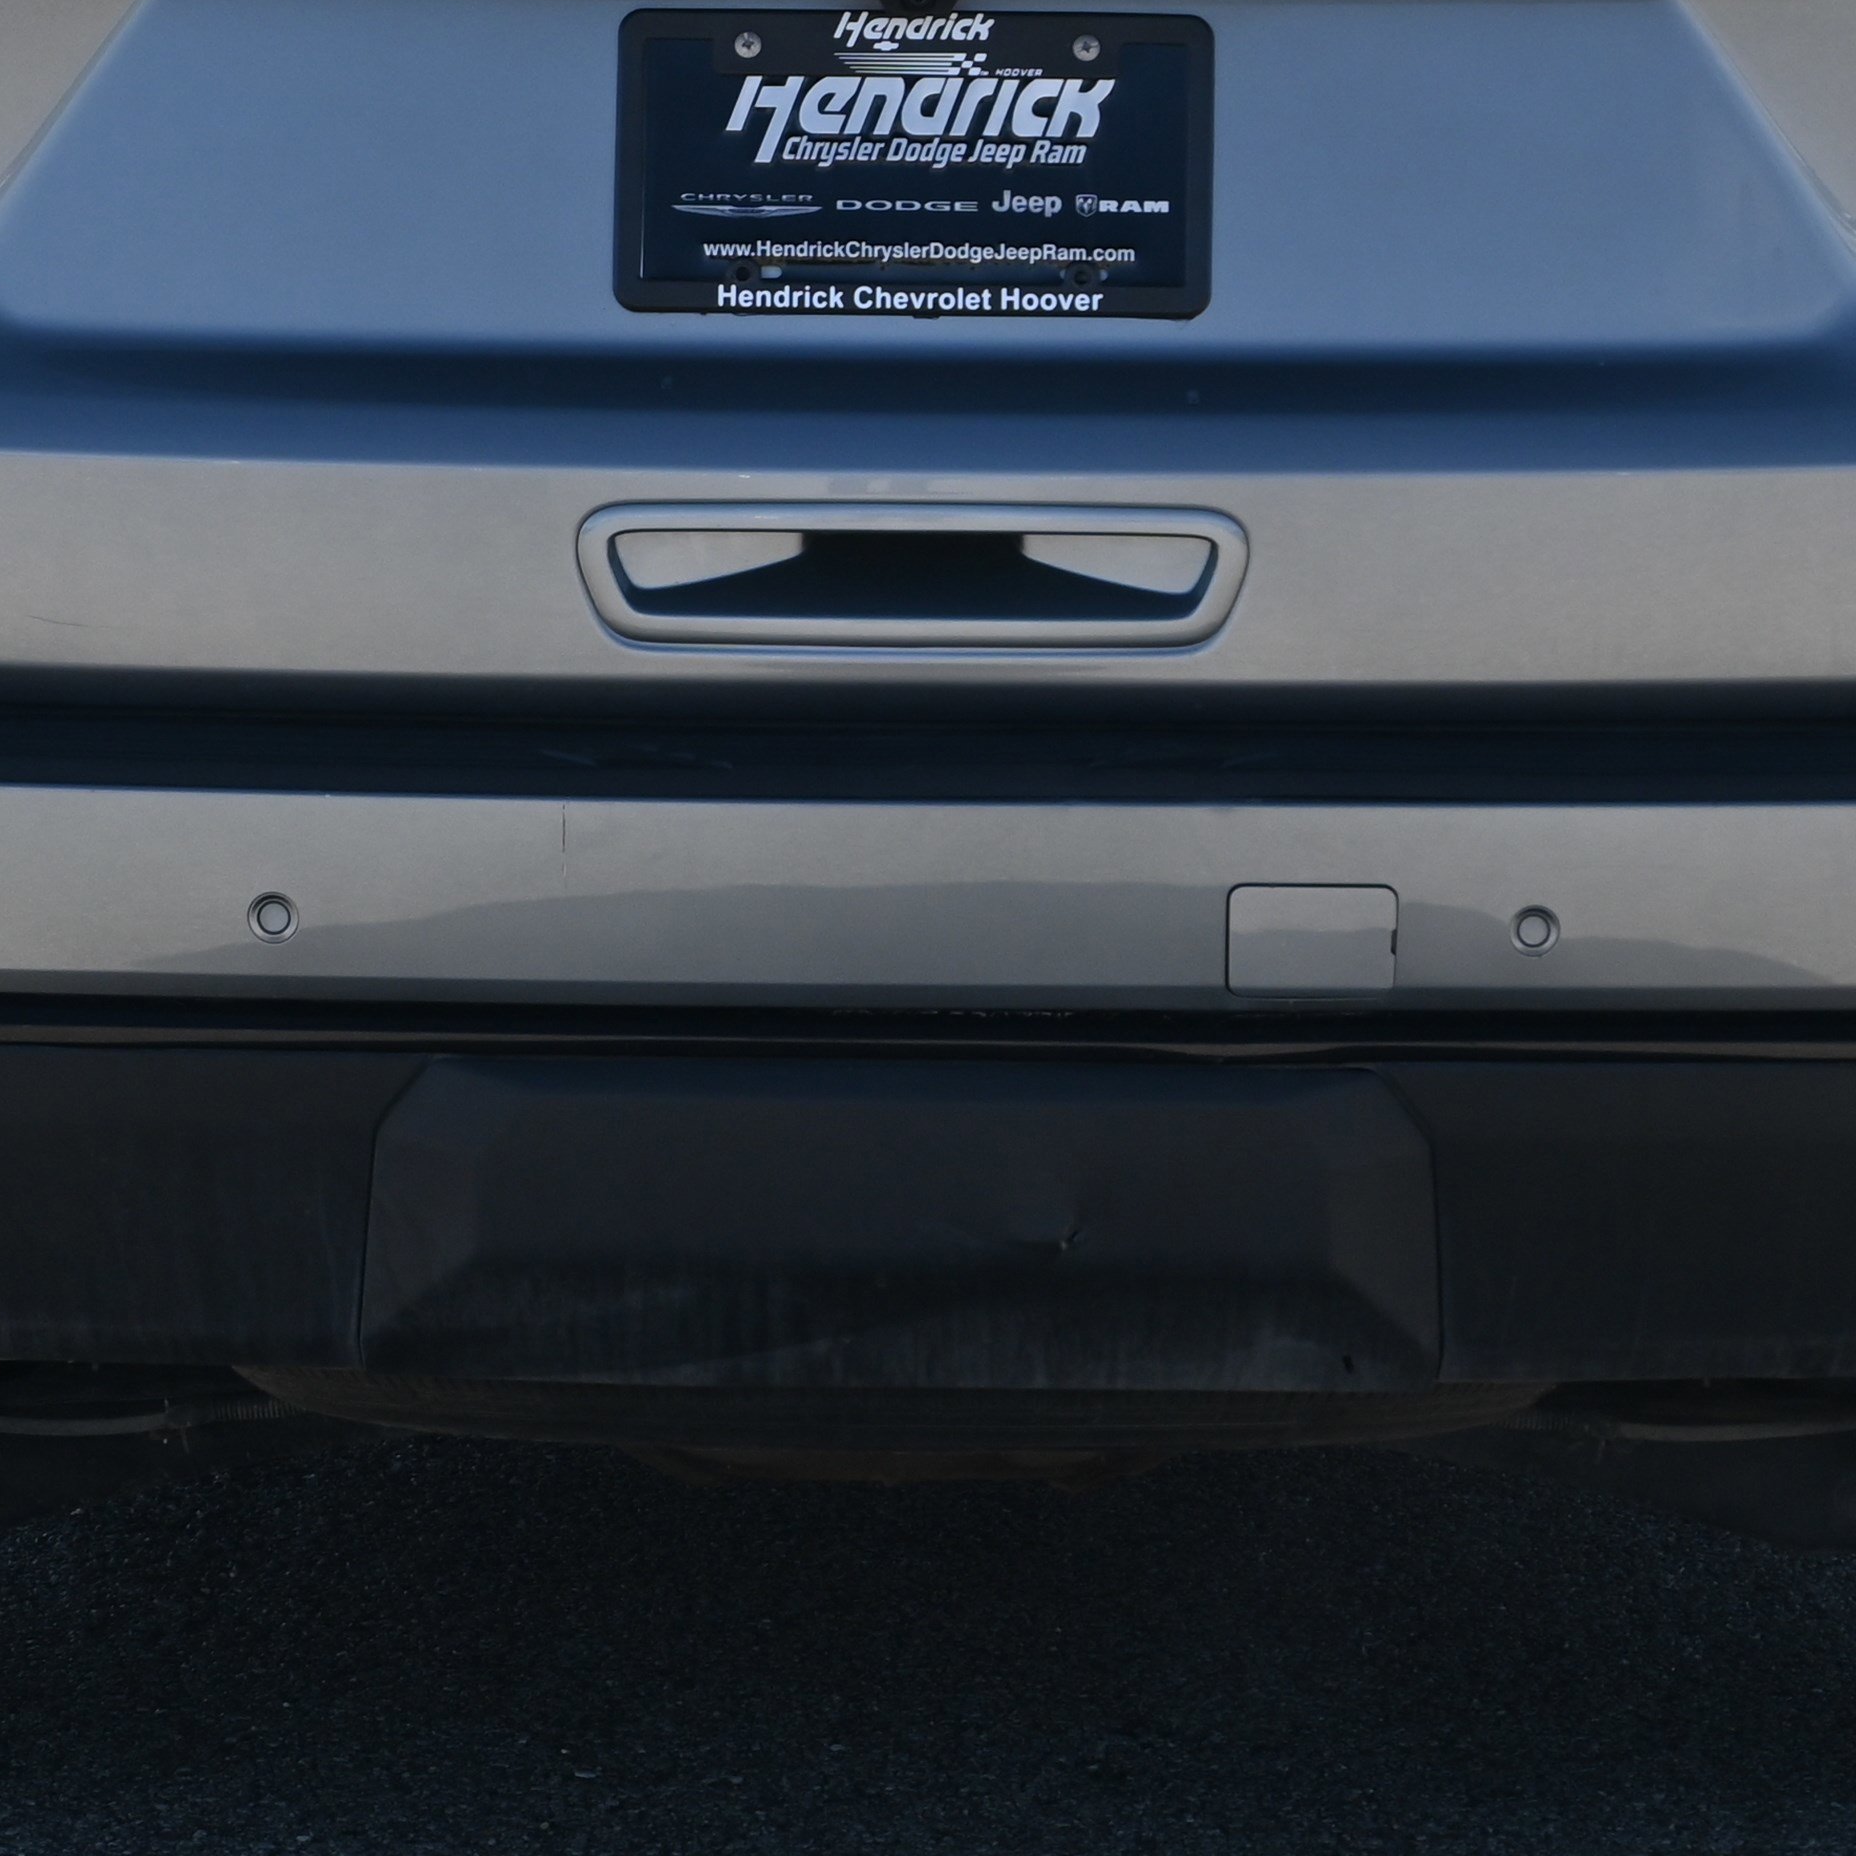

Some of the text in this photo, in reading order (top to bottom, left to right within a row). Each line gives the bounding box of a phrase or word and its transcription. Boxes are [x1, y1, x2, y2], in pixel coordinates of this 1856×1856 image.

[833, 11, 995, 48] Hendrick
[995, 68, 1043, 77] HOOVER
[725, 75, 1116, 164] Hendrick
[781, 136, 1087, 169] Chrysler Dodge Jeep Ram
[680, 190, 1170, 218] CHRYSLER DODGE Jeep RAM
[703, 241, 1136, 263] www.HendrickChryslerDodgeJeepRam.com
[717, 284, 1104, 312] Hendrick Chevrolet Hoover
